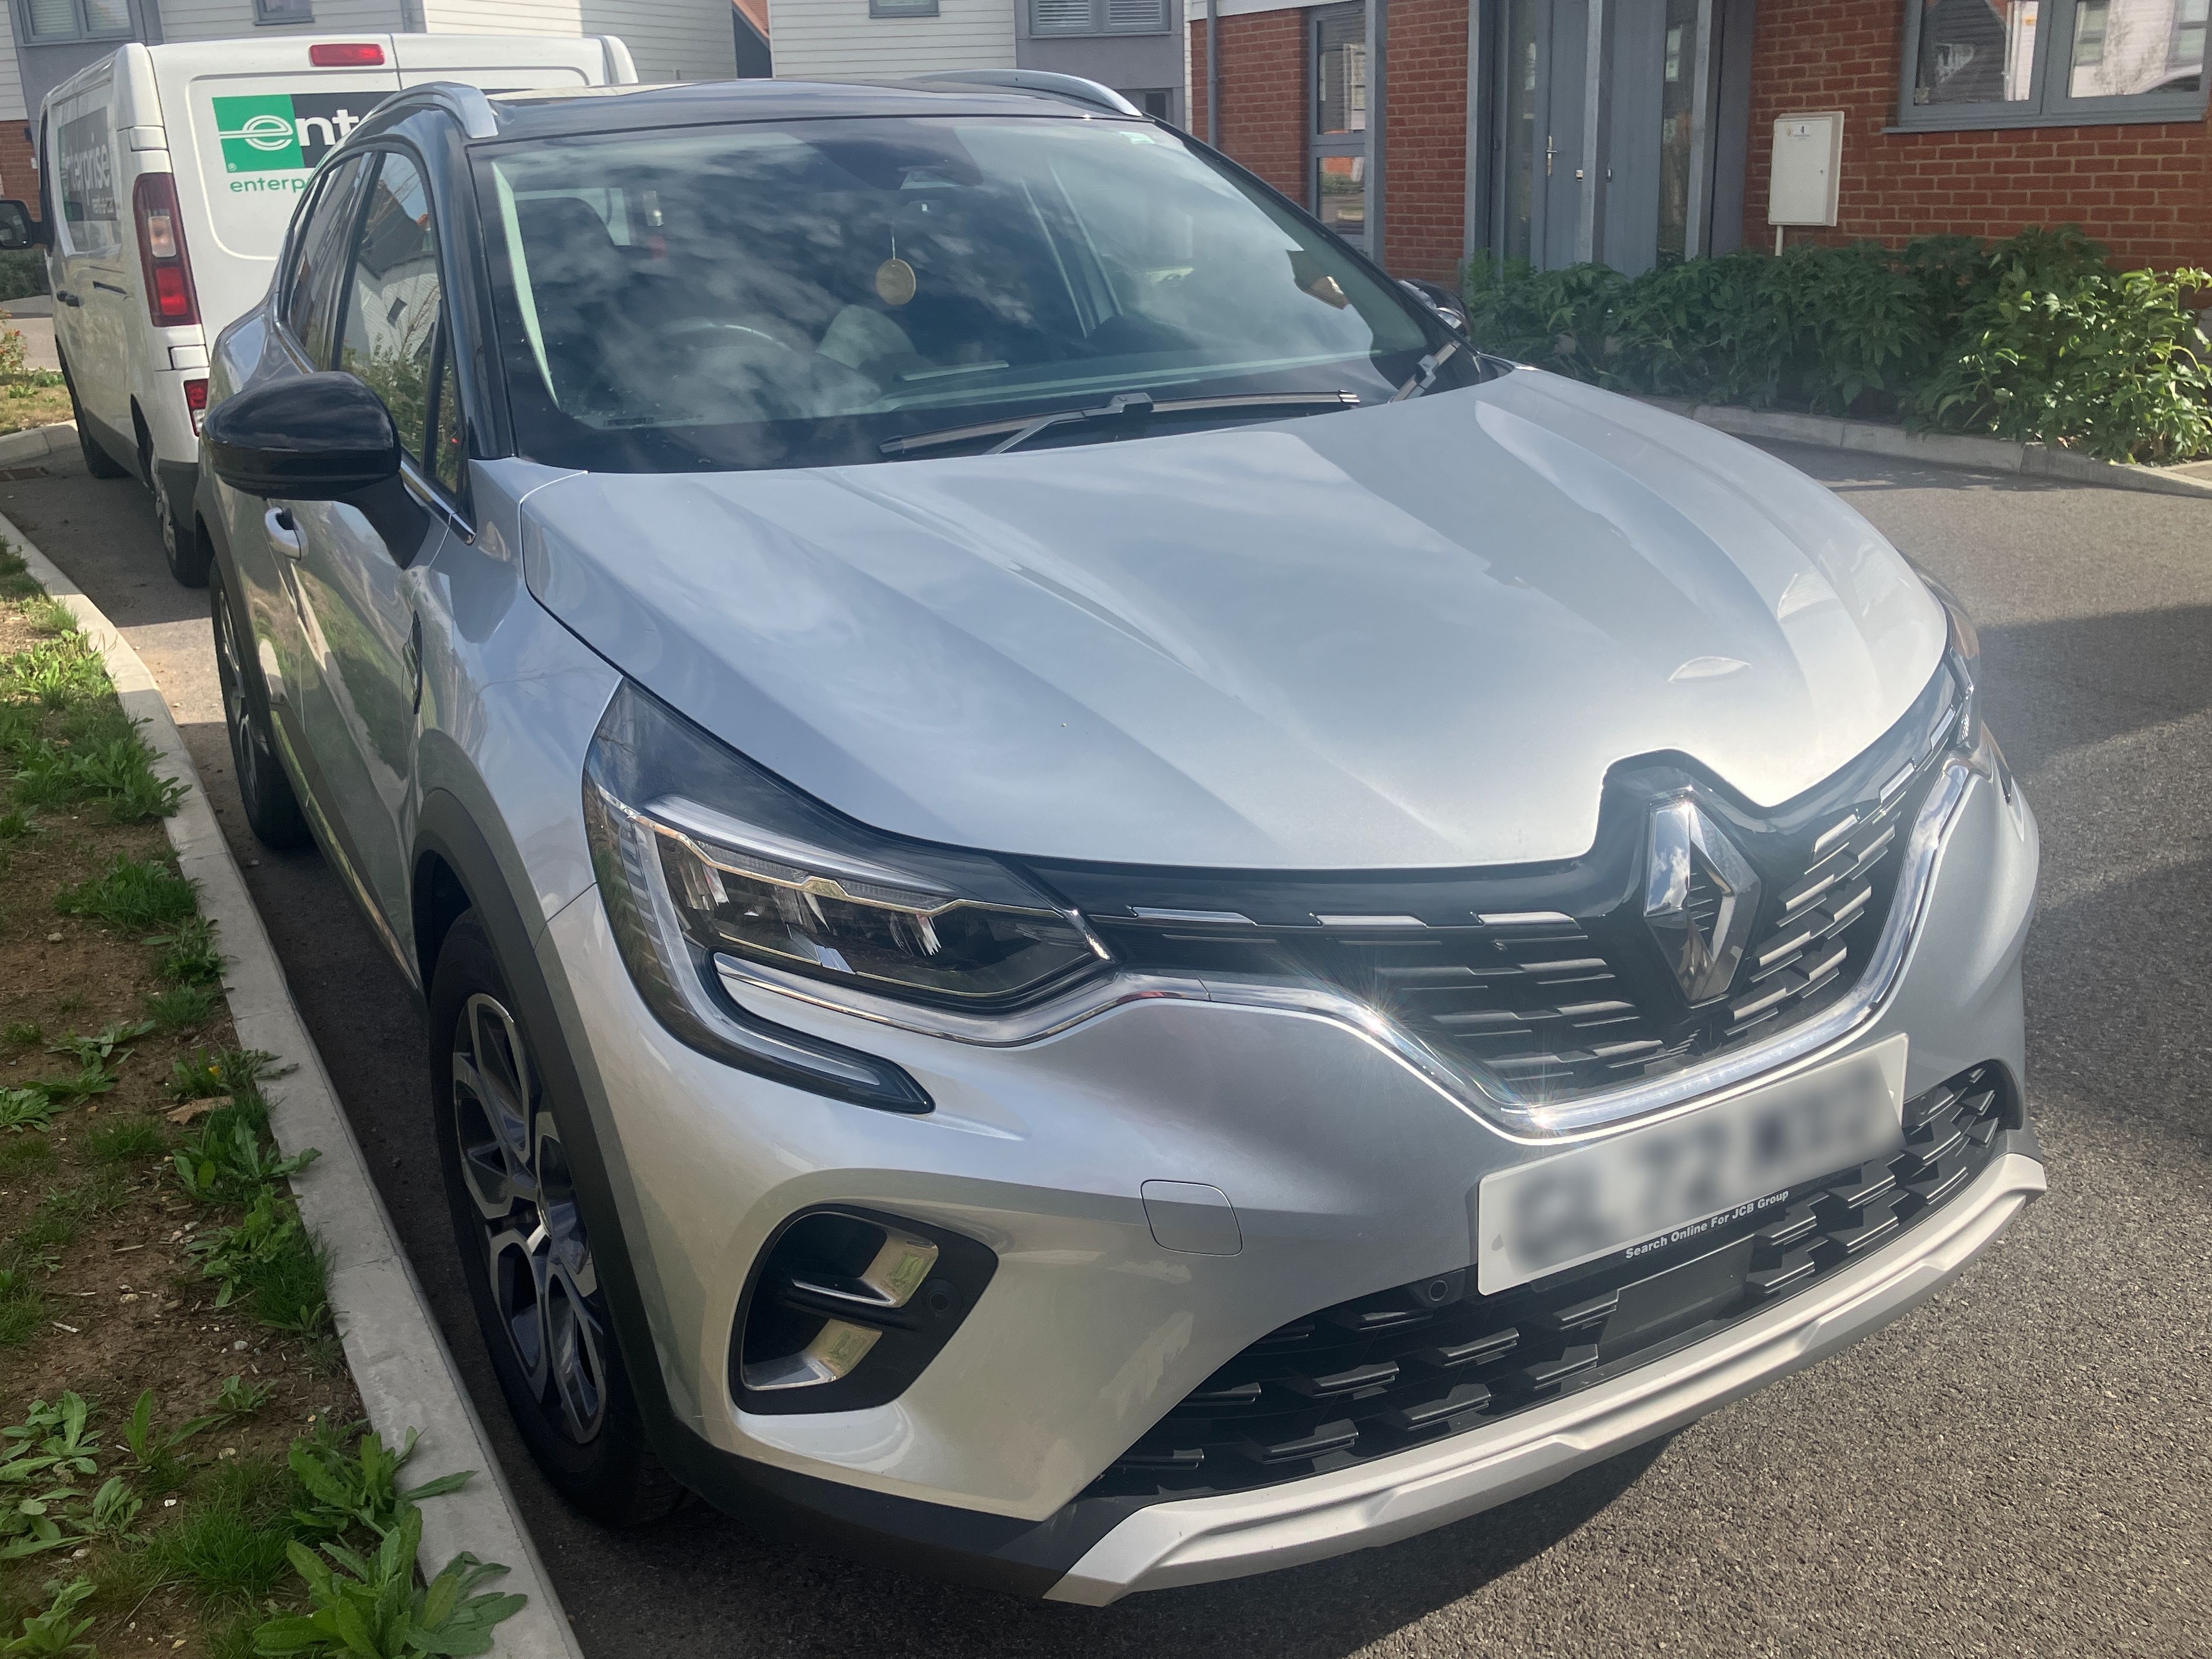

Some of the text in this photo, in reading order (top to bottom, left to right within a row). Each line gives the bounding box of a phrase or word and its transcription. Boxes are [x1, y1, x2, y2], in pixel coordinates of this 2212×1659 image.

[230, 177, 310, 193] enterp
[1625, 1190, 1789, 1259] Search Online For JCB Group
